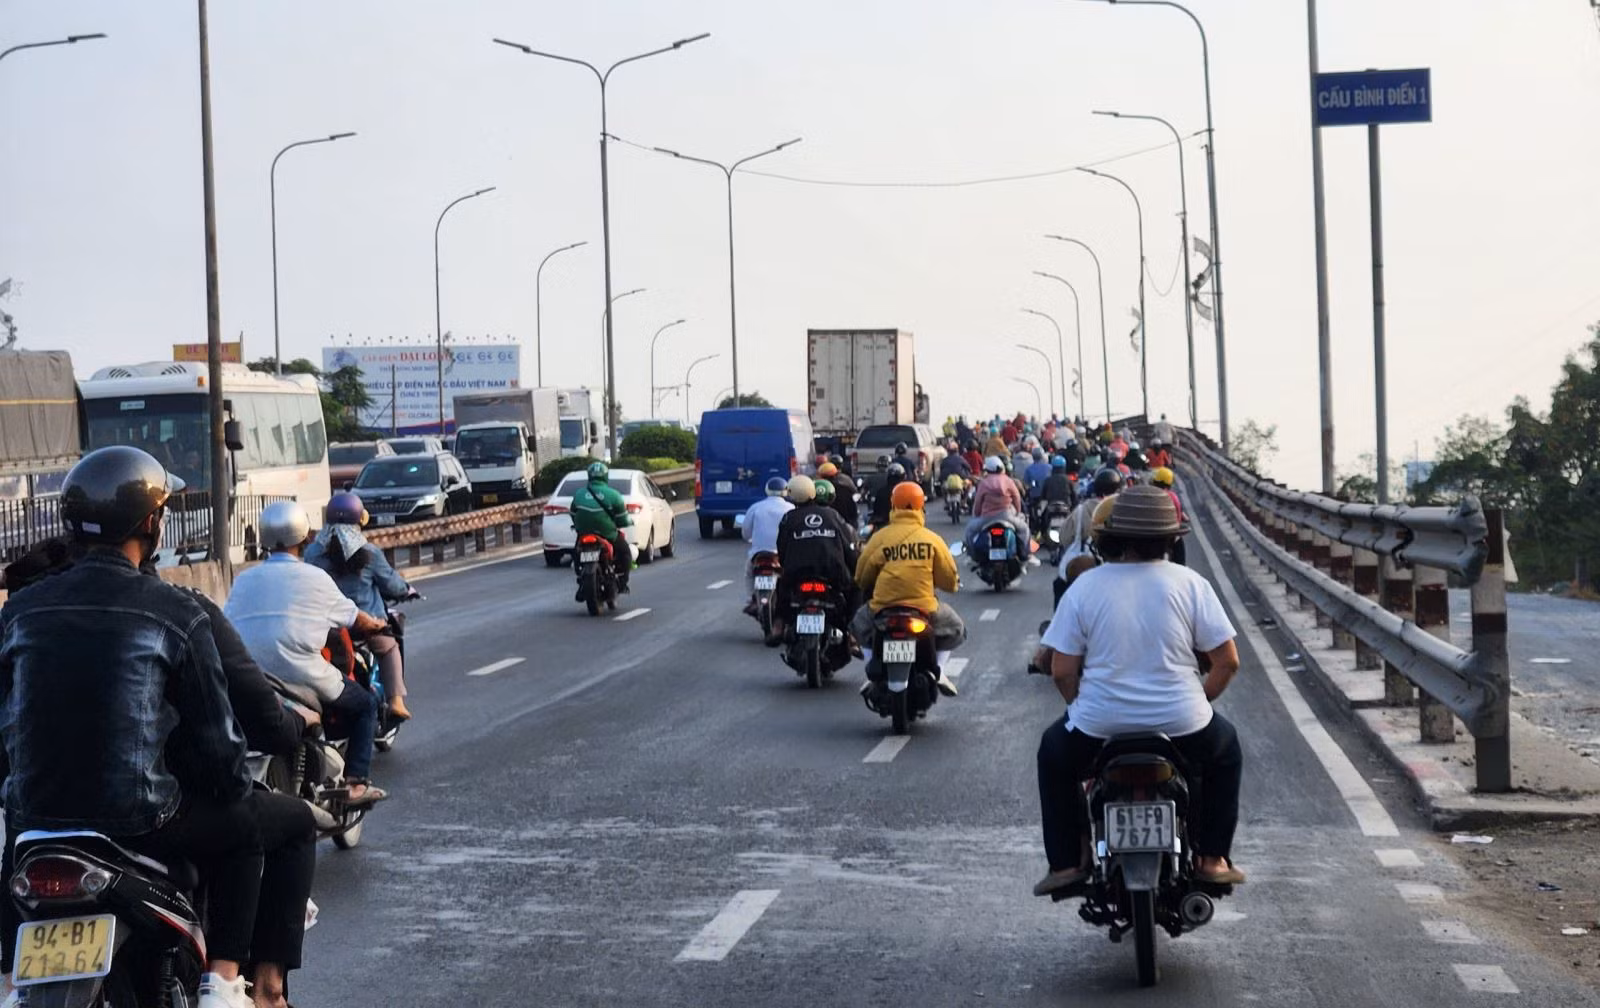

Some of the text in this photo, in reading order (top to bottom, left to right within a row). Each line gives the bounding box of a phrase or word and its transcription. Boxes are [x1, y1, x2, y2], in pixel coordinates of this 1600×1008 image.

[1420, 87, 1427, 104] 1
[487, 379, 506, 388] NAM
[793, 529, 836, 539] LEXUS
[1116, 827, 1163, 848] 7671
[33, 920, 96, 950] 94-B1
